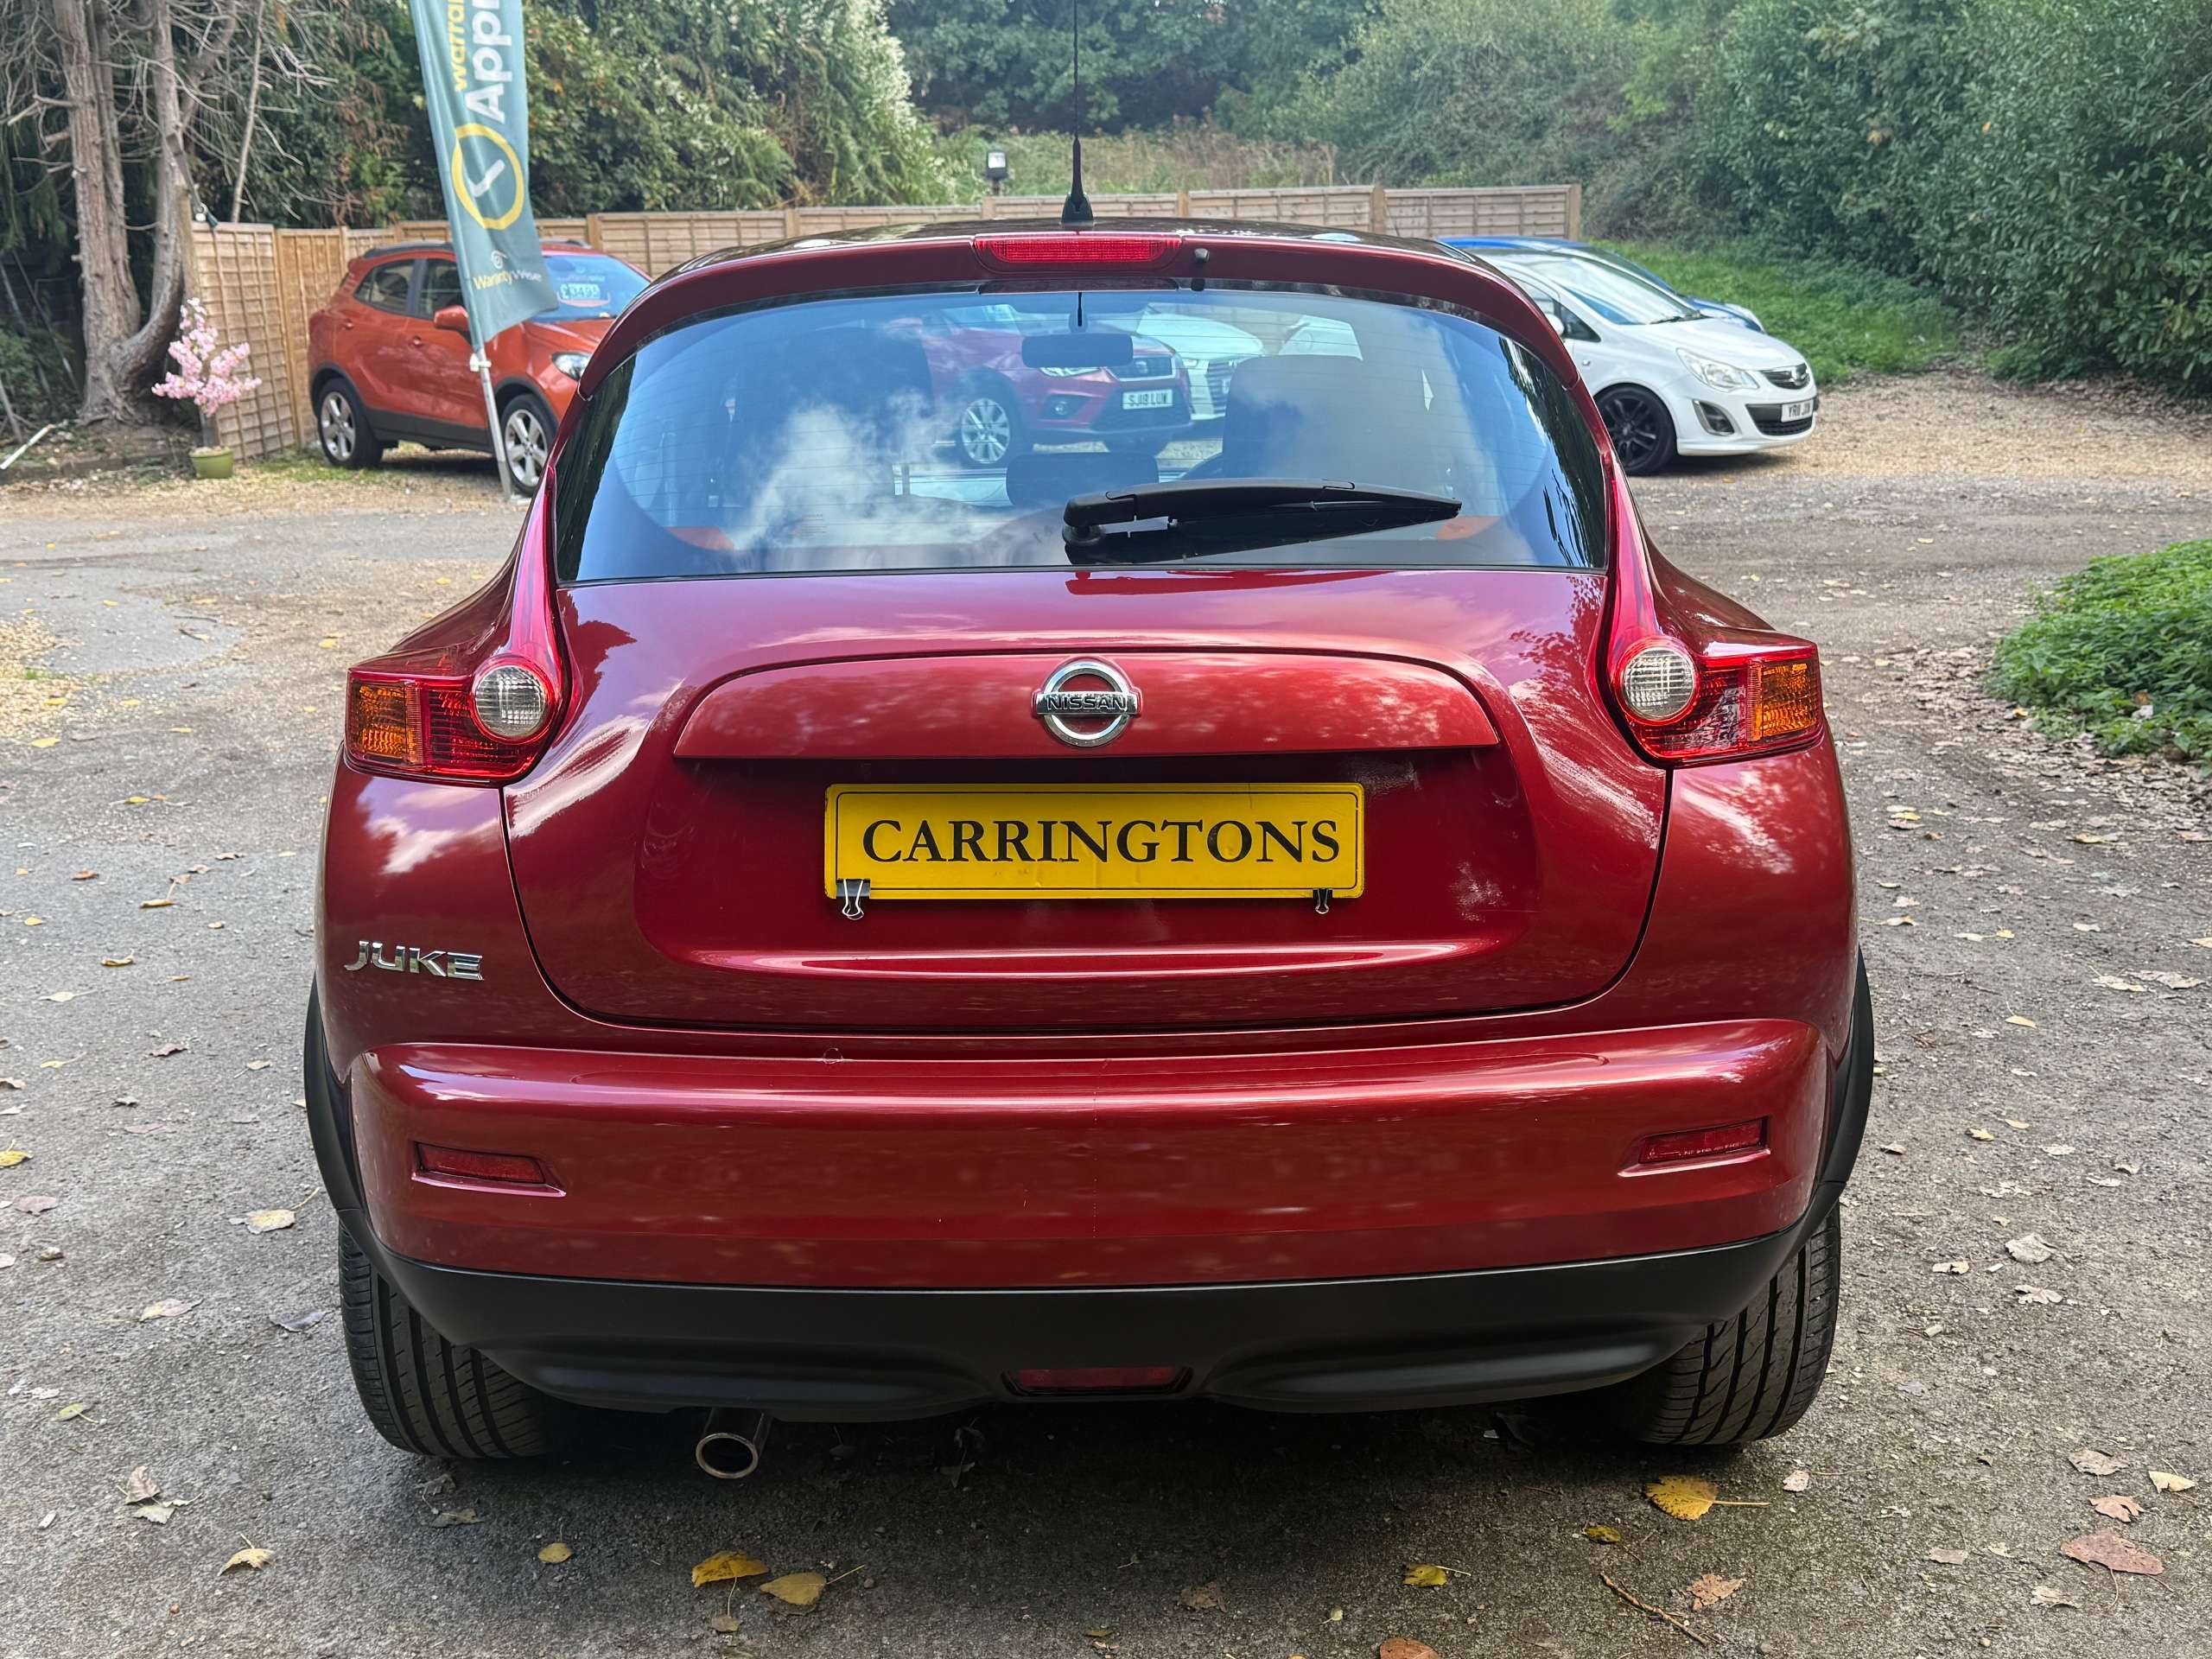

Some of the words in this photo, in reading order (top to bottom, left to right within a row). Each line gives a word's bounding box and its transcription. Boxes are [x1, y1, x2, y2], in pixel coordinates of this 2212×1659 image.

[1046, 696, 1128, 711] NISSAN
[862, 819, 1340, 863] CARRINGTONS
[343, 940, 485, 981] JUKE
